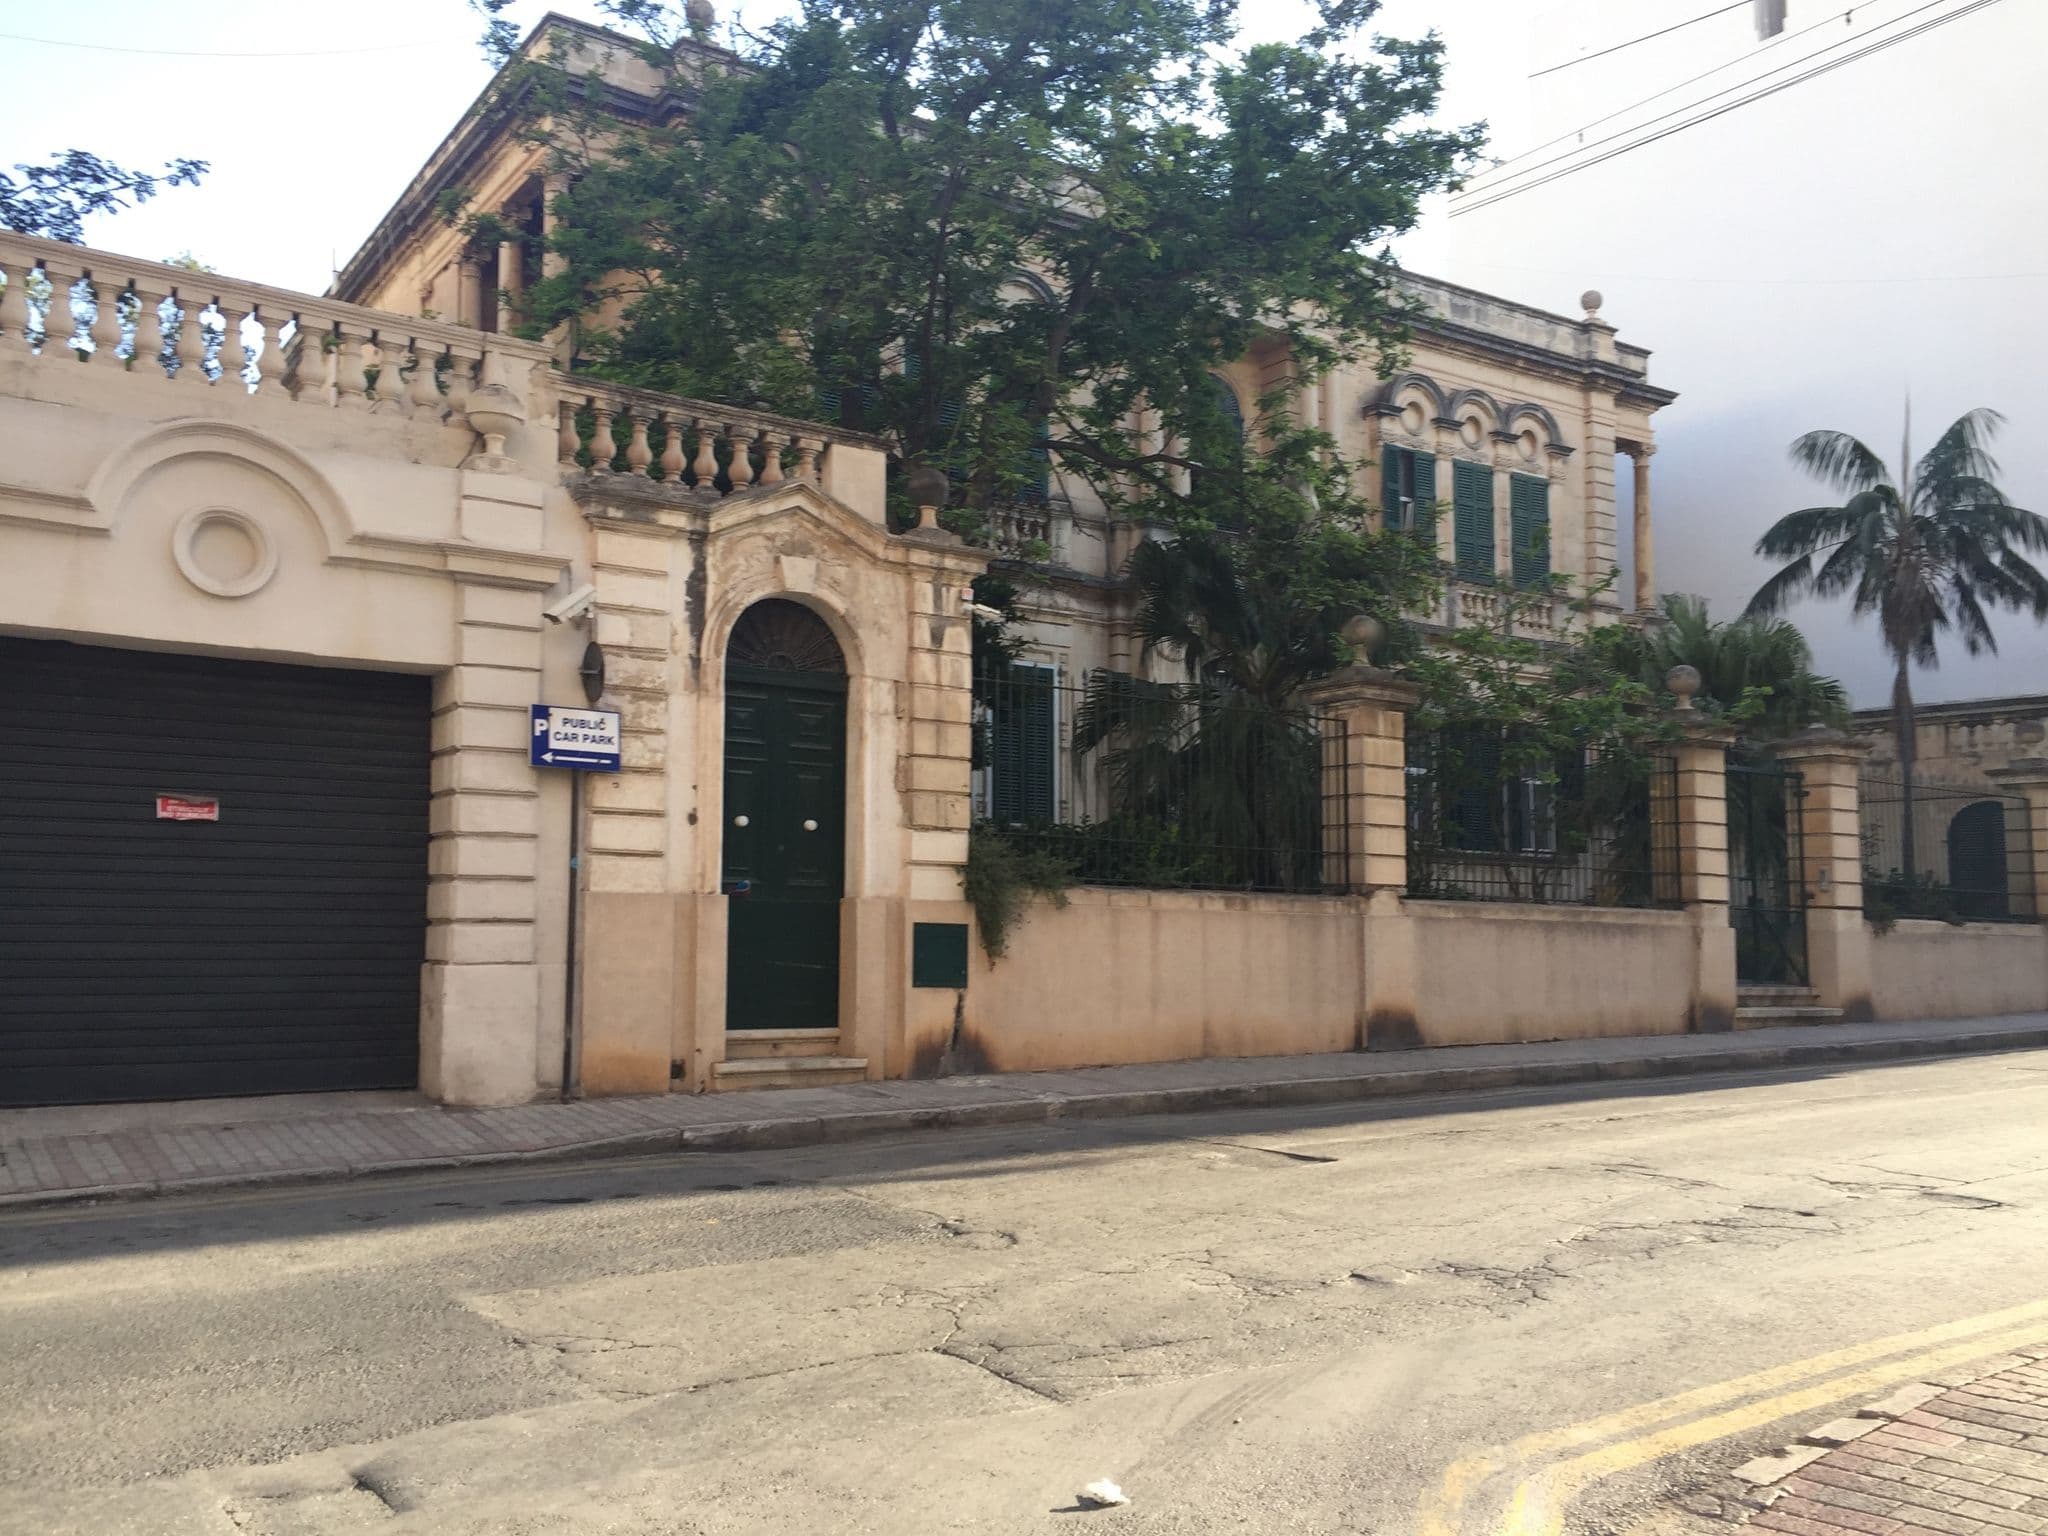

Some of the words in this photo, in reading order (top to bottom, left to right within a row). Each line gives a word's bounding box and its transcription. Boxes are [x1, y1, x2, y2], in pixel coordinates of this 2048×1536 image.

[534, 718, 548, 736] P
[562, 717, 606, 731] PUBLIC
[553, 731, 579, 743] CAR
[582, 733, 615, 746] PARK
